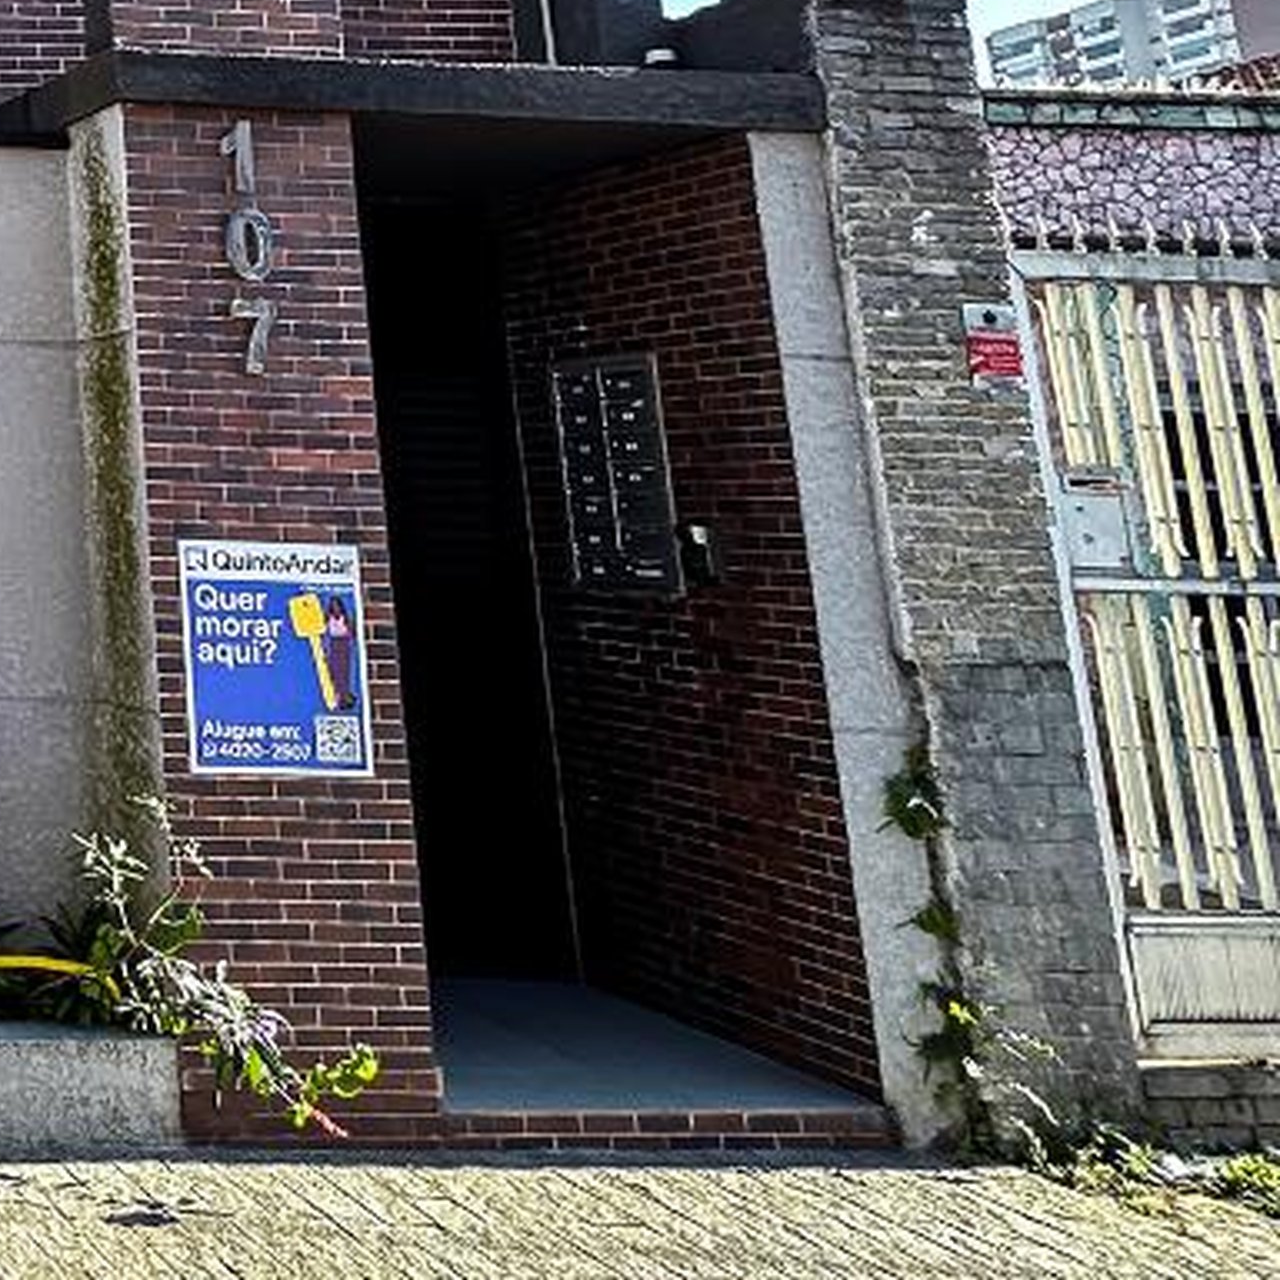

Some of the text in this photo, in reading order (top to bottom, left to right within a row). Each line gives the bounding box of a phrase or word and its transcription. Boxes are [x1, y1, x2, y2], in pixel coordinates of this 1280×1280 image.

[212, 549, 354, 575] QuintoAndar
[194, 583, 268, 610] Quer
[195, 616, 283, 638] morar
[196, 639, 278, 668] aqui?
[202, 719, 266, 740] Alugue
